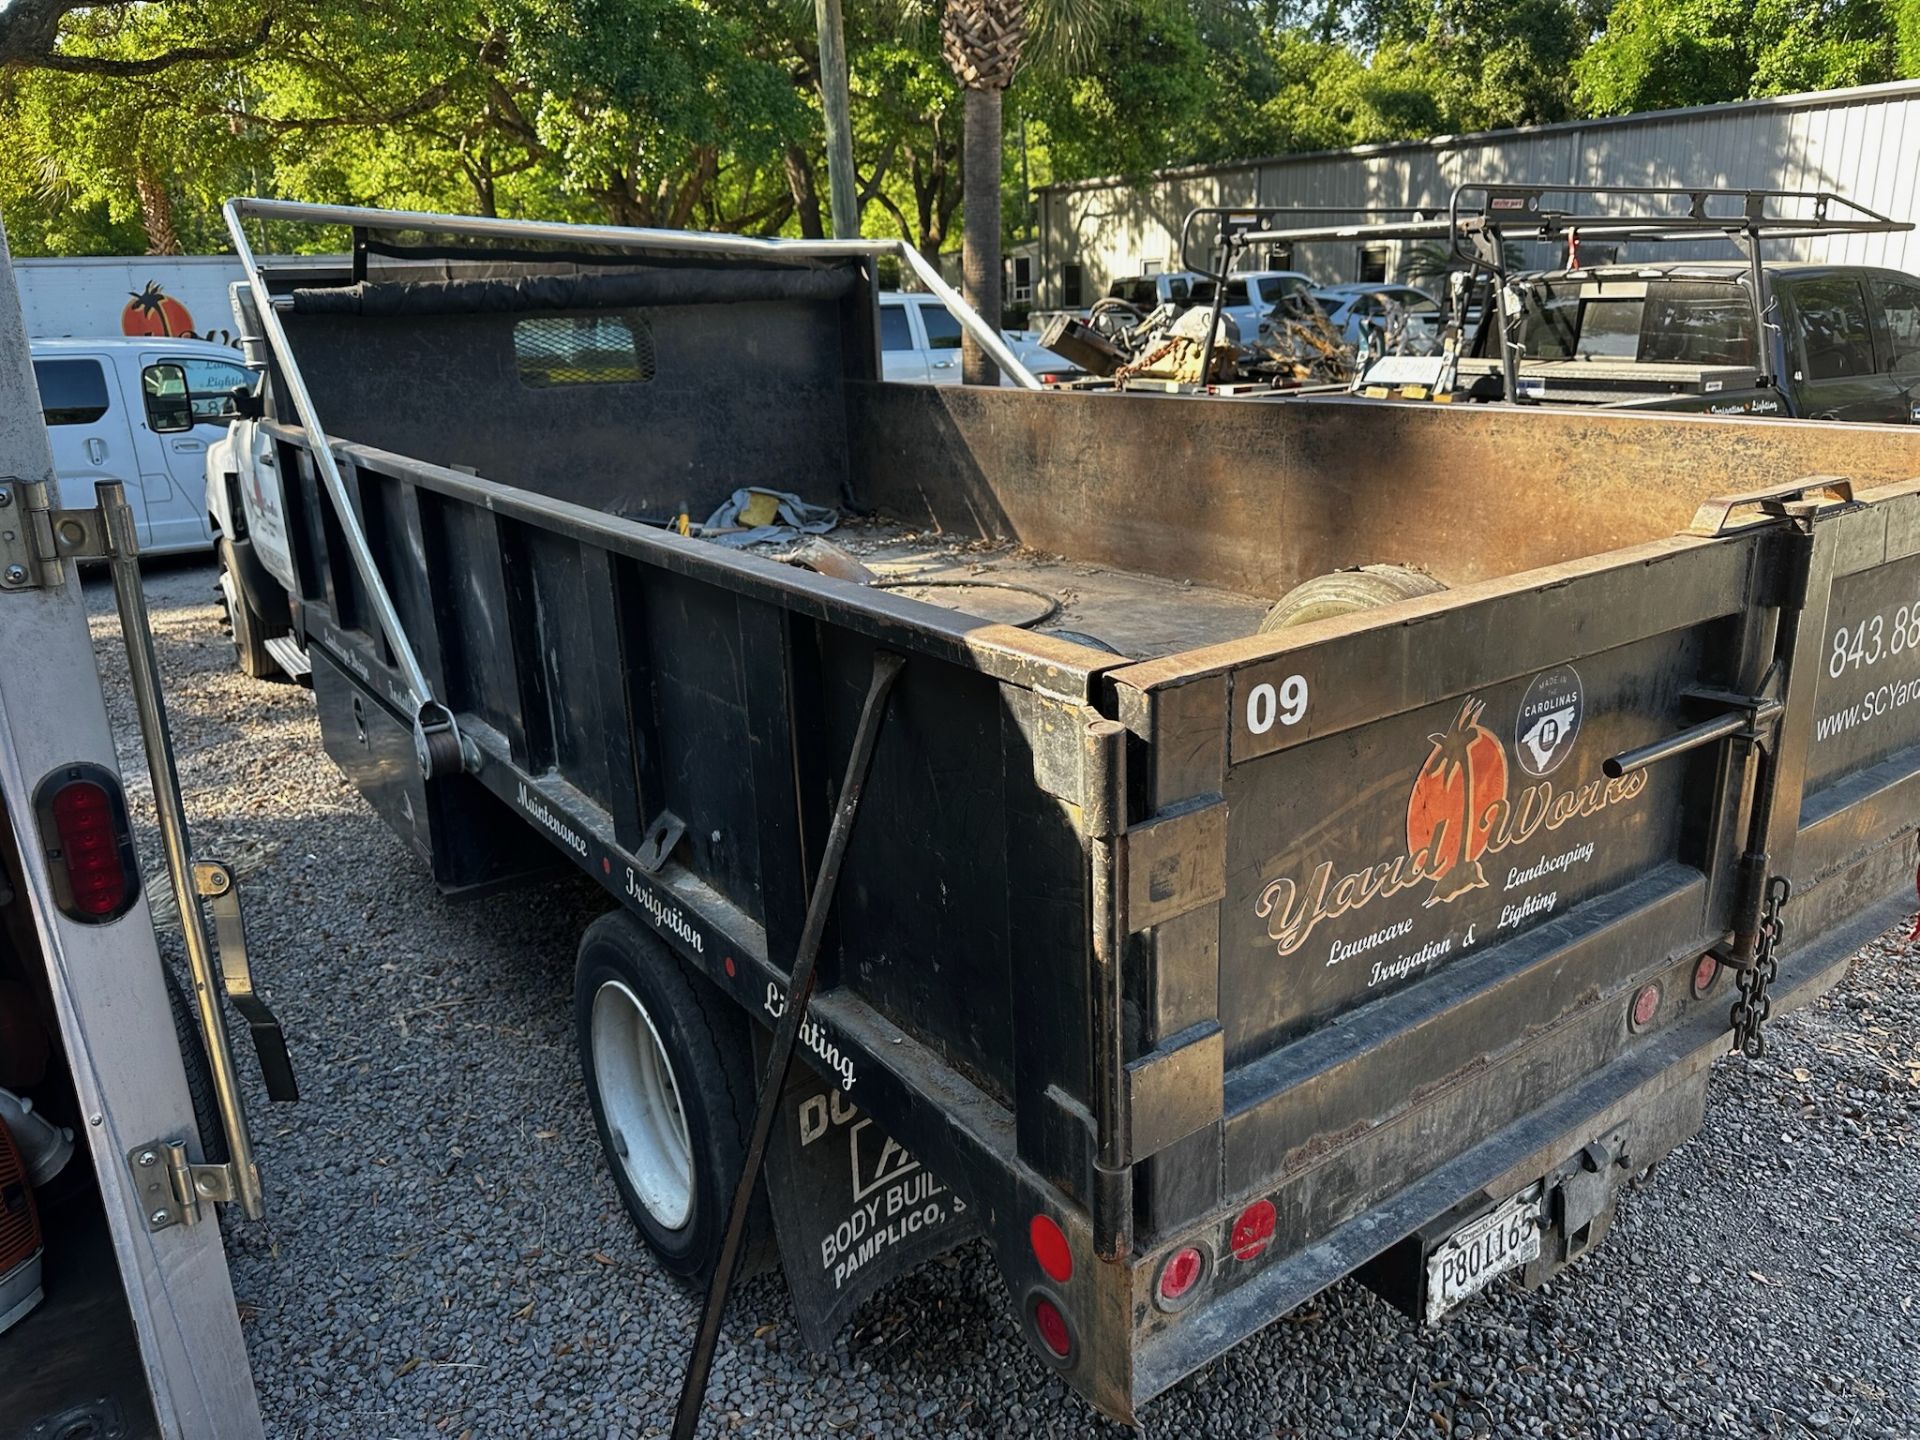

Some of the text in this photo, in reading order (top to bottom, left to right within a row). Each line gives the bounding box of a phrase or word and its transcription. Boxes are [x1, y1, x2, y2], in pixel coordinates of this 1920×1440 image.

[1538, 675, 1569, 690] MADE IN
[1829, 600, 1920, 679] 843.88
[1246, 674, 1309, 735] 09
[1524, 690, 1578, 718] CAROLINAS
[517, 781, 588, 858] Maintenance
[624, 866, 705, 954] Irrigation
[1255, 818, 1452, 957] Yard
[1325, 839, 1595, 968] Lawncare Landscaping
[1367, 938, 1452, 988] Irrigation
[1497, 890, 1558, 931] Lighting
[763, 981, 857, 1092] Lihting
[821, 1170, 948, 1270] BODY BUIL
[834, 1203, 946, 1290] PAMPLICO,
[1441, 1205, 1534, 1301] P801165
